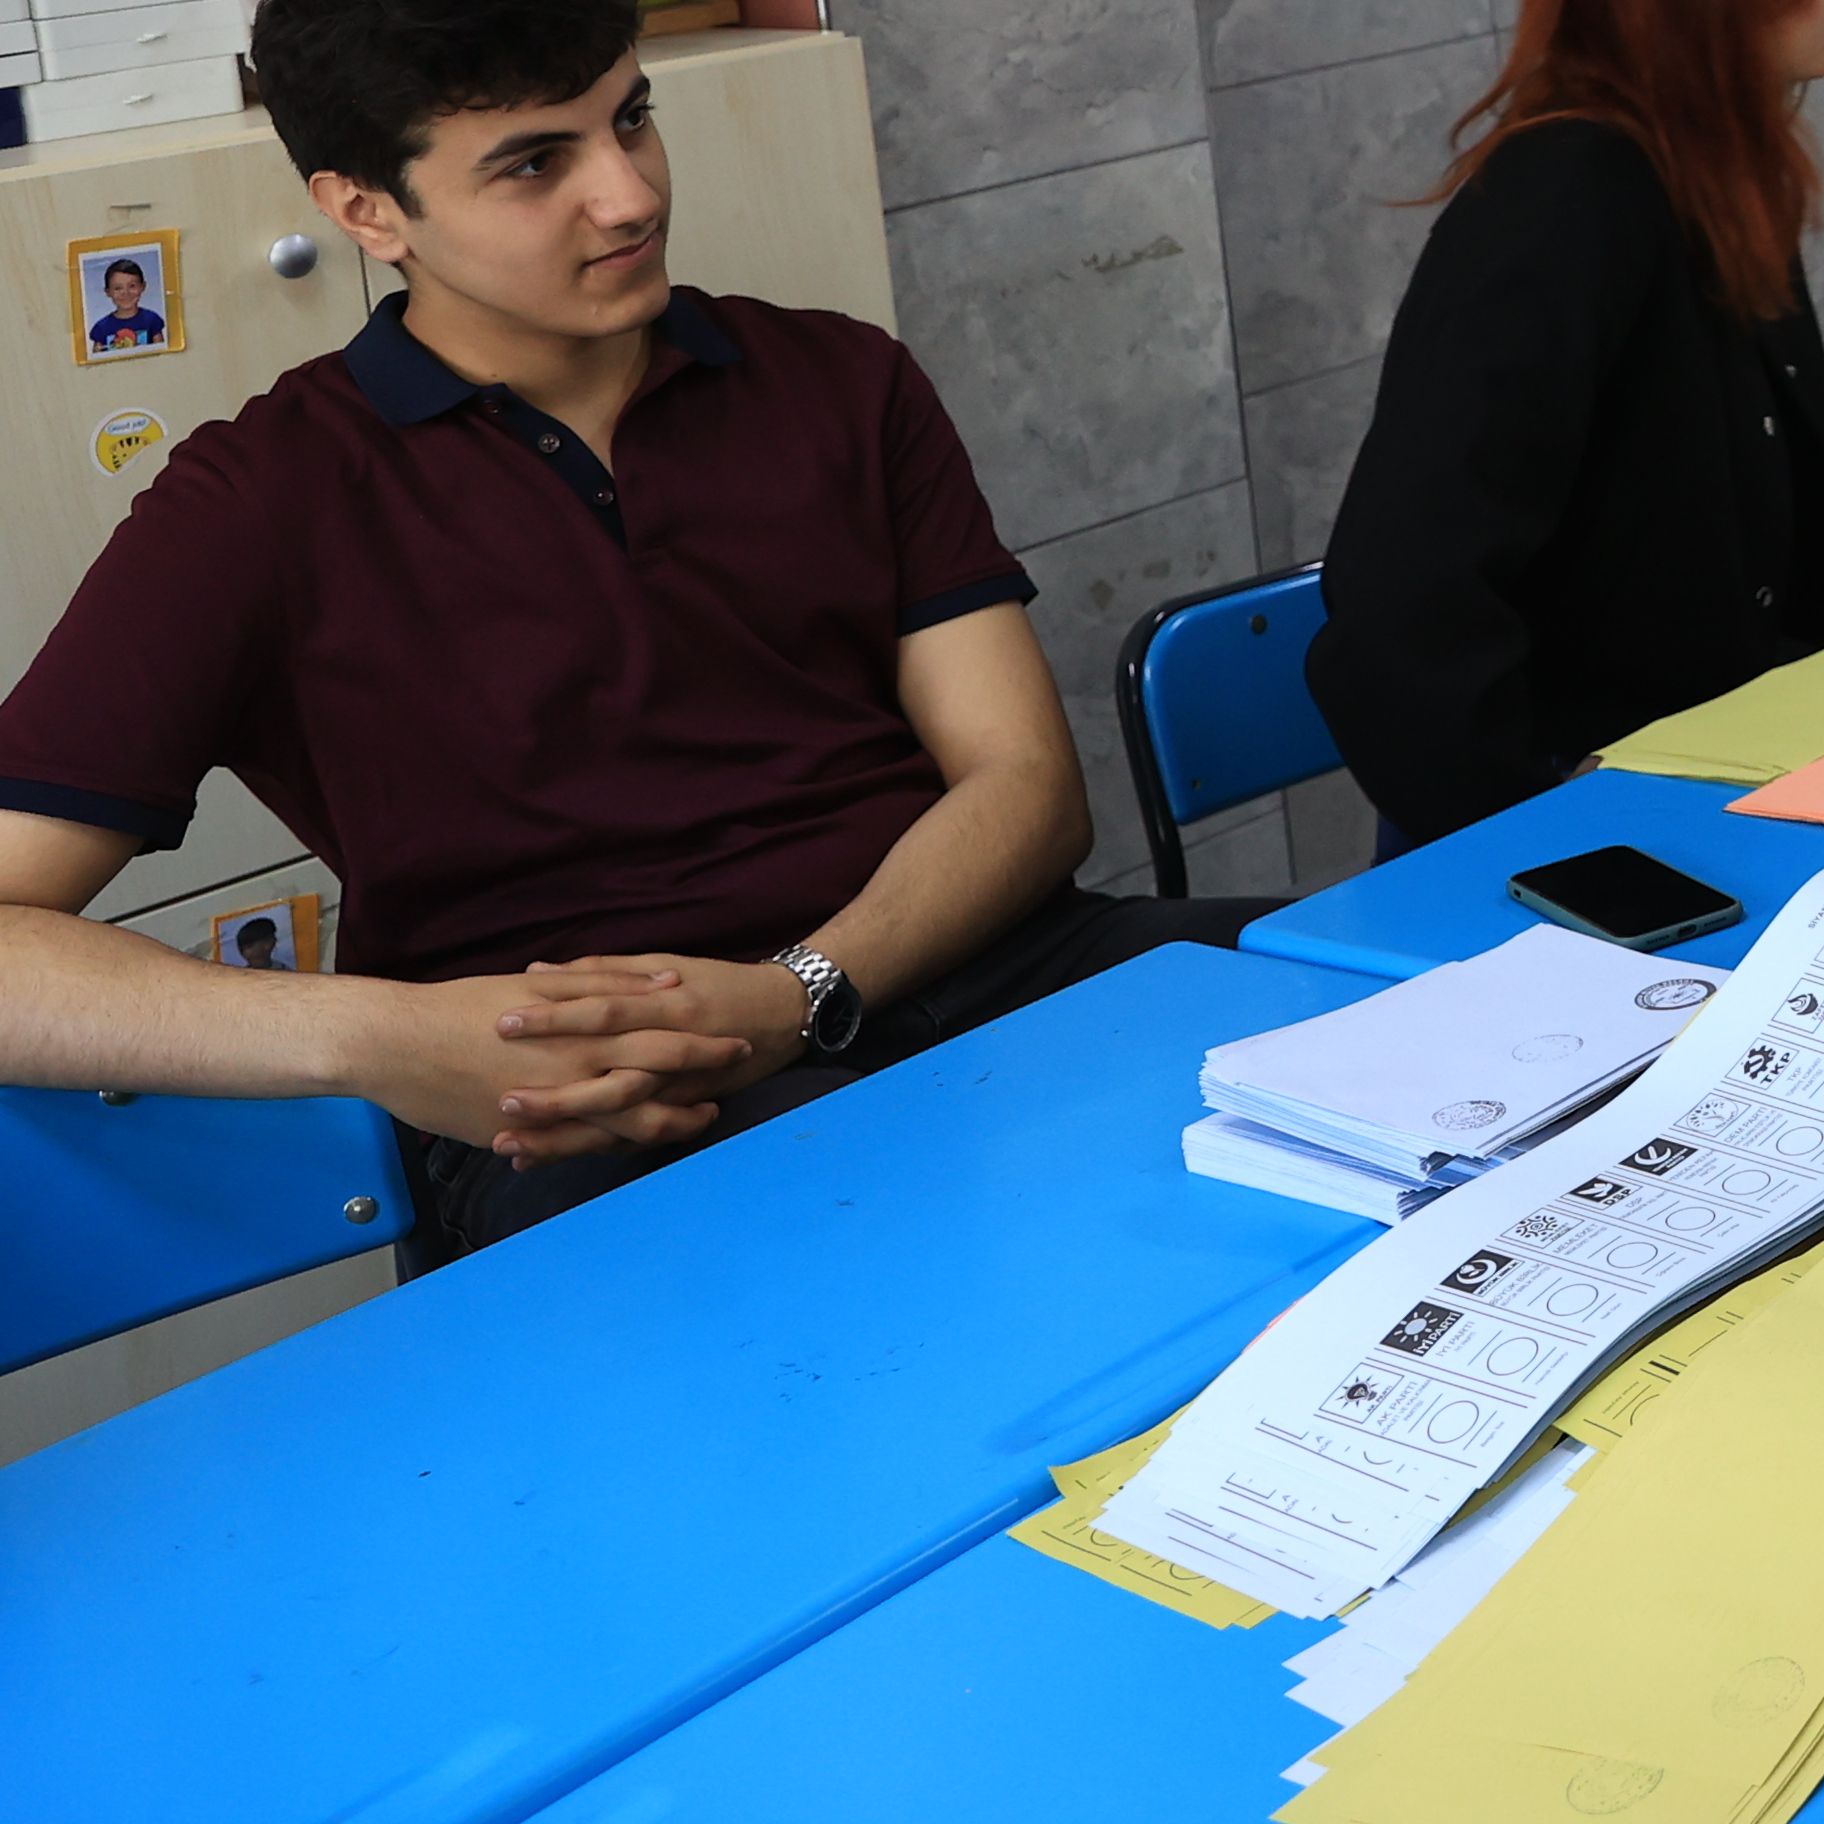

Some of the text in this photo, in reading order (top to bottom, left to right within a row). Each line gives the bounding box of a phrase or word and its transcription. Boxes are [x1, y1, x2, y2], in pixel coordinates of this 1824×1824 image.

[1759, 1051, 1793, 1089] TKP
[1602, 1188, 1633, 1206] DSP
[1412, 1310, 1461, 1356] İYİ PARTİ
[1376, 1379, 1418, 1427] AK PARTİ
